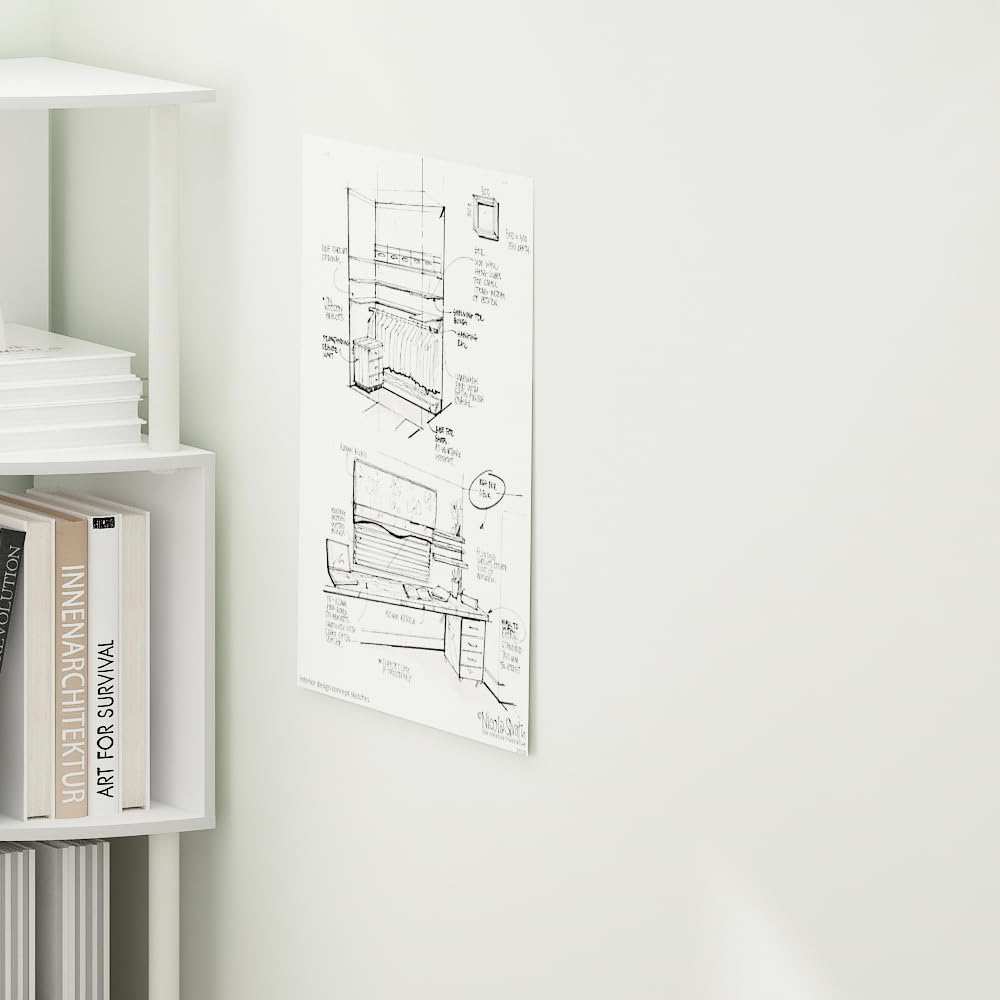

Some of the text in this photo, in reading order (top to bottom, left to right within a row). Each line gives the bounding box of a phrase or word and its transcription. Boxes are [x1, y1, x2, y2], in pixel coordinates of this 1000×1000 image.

[61, 564, 87, 804] INNENARCHITEKTUR
[97, 639, 114, 798] ART FOR SURVIVAL
